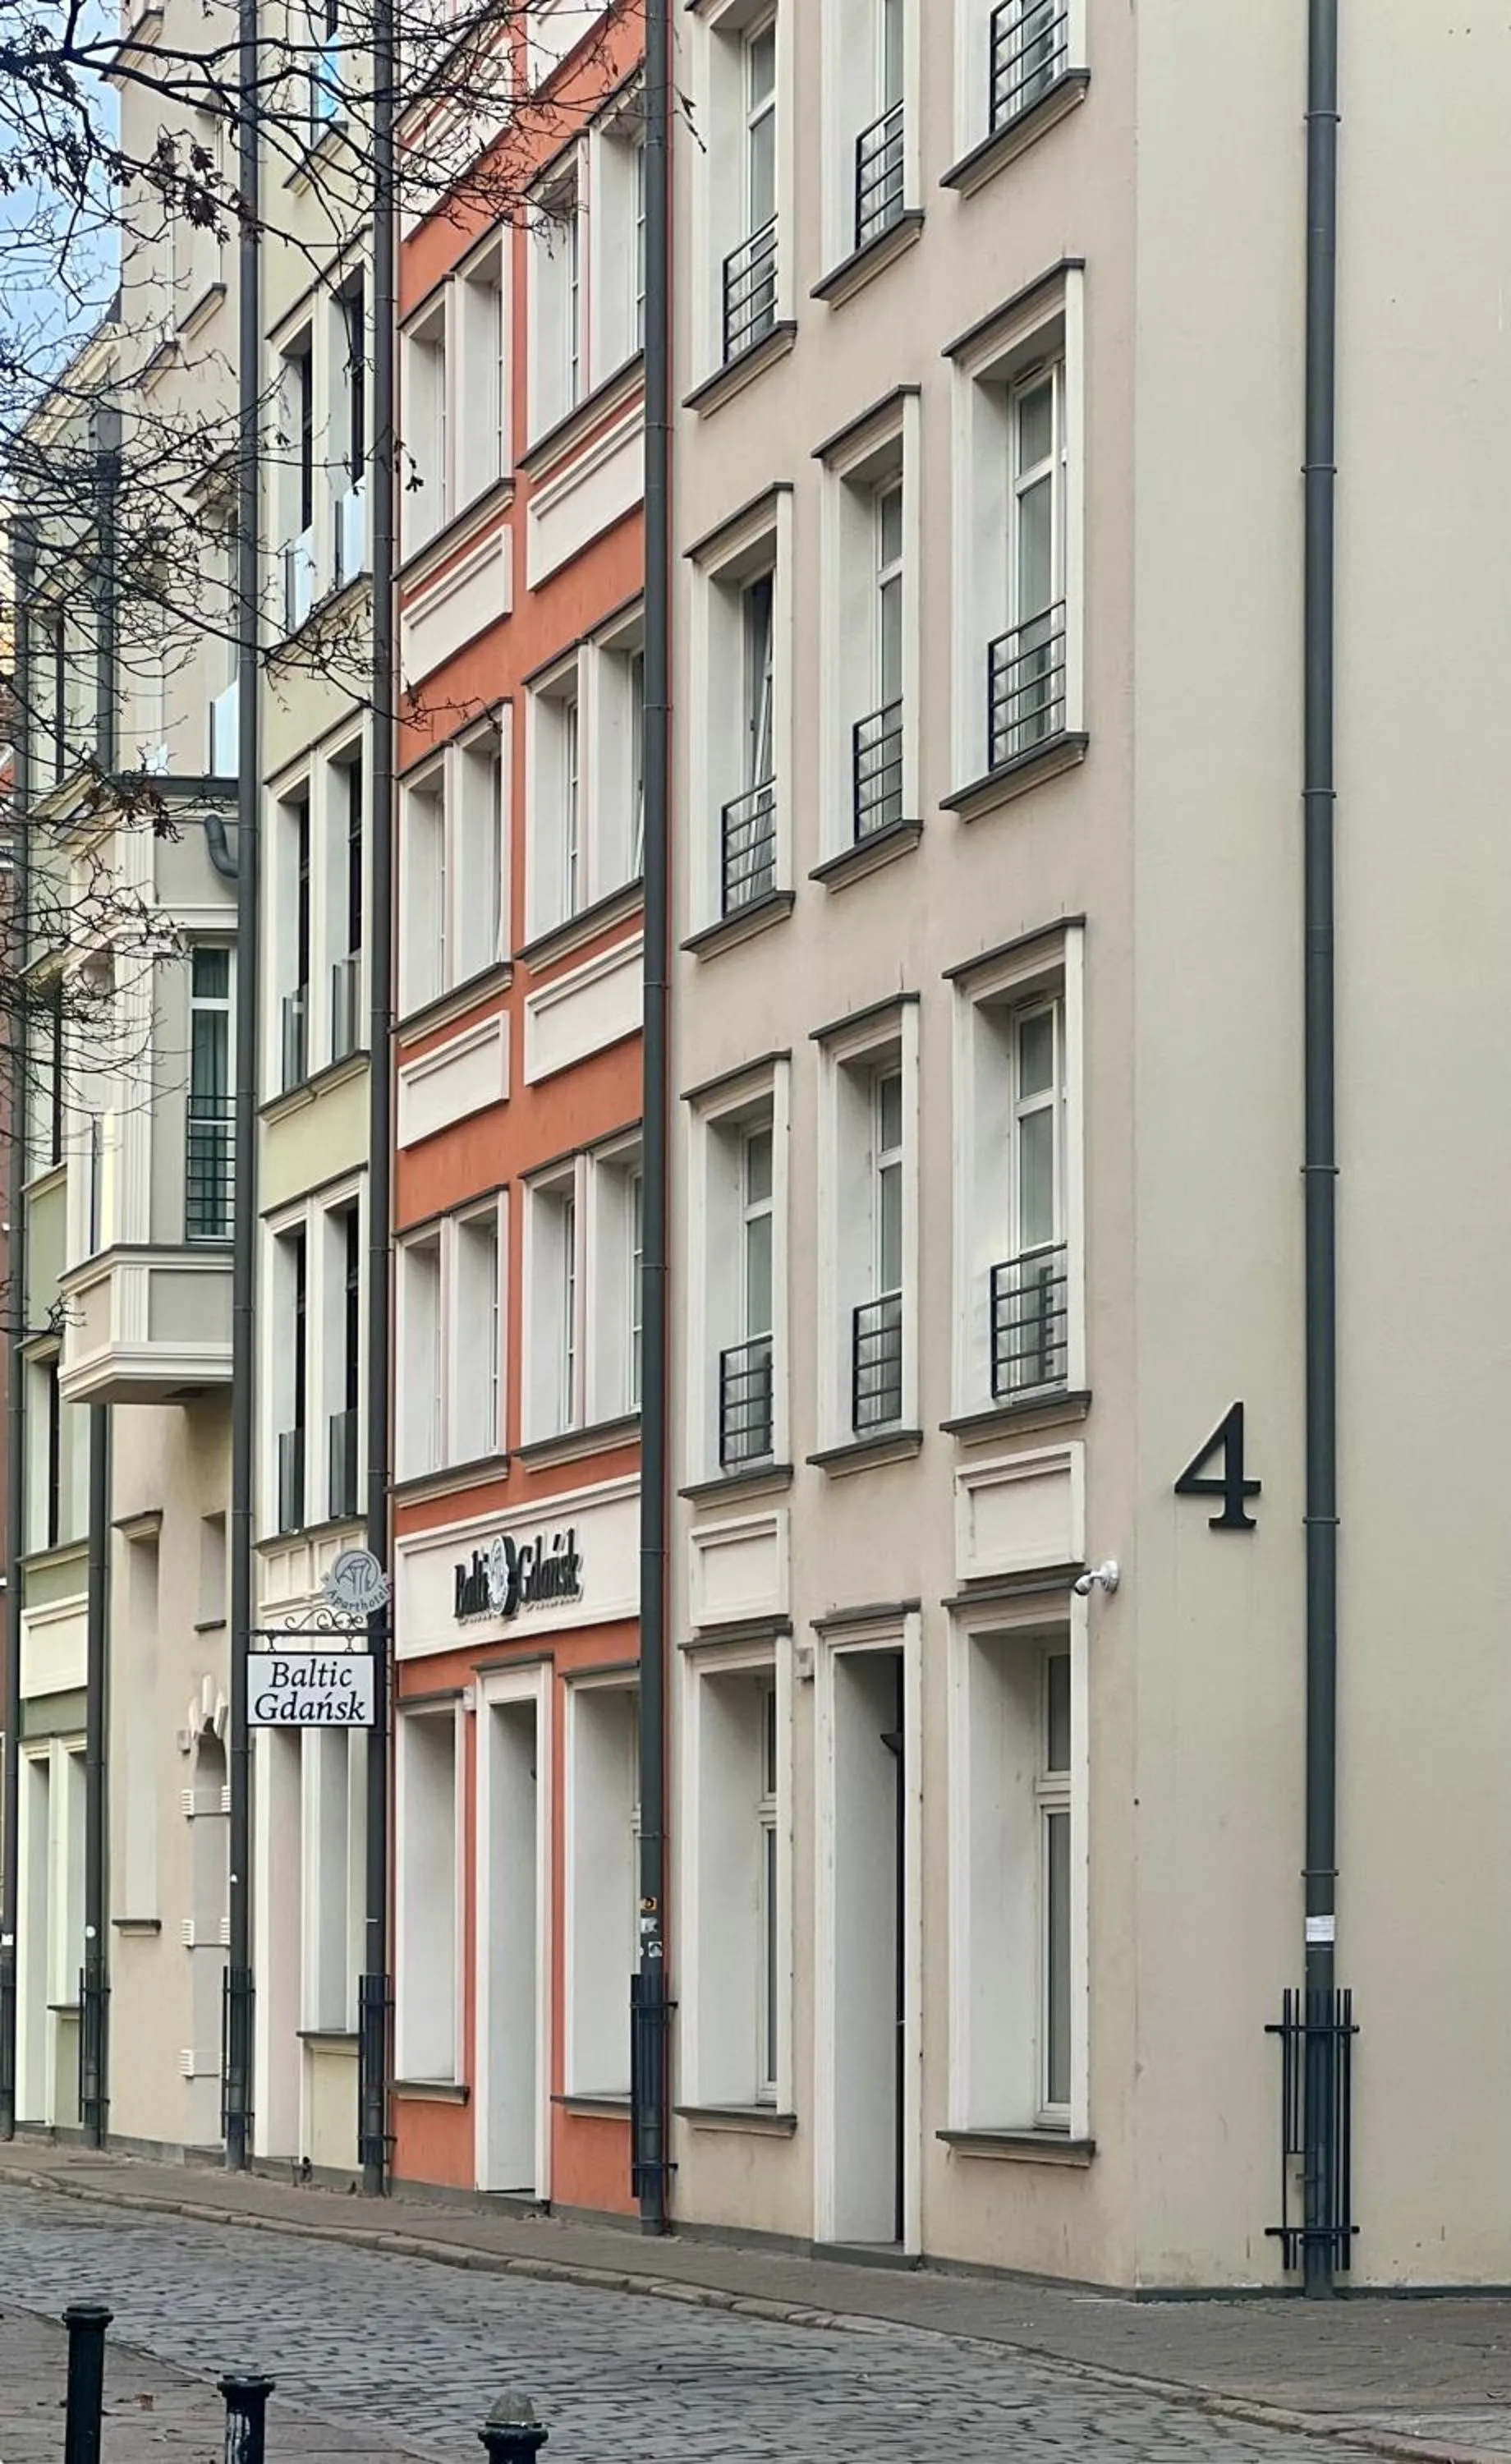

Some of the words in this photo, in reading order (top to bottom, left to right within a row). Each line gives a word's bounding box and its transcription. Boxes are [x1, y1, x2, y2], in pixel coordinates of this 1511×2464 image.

[1174, 1400, 1262, 1529] 4
[328, 1584, 388, 1612] Aparthotel
[453, 1550, 490, 1618] Balti
[269, 1657, 352, 1688] Baltic
[255, 1690, 365, 1721] Gdańsk
